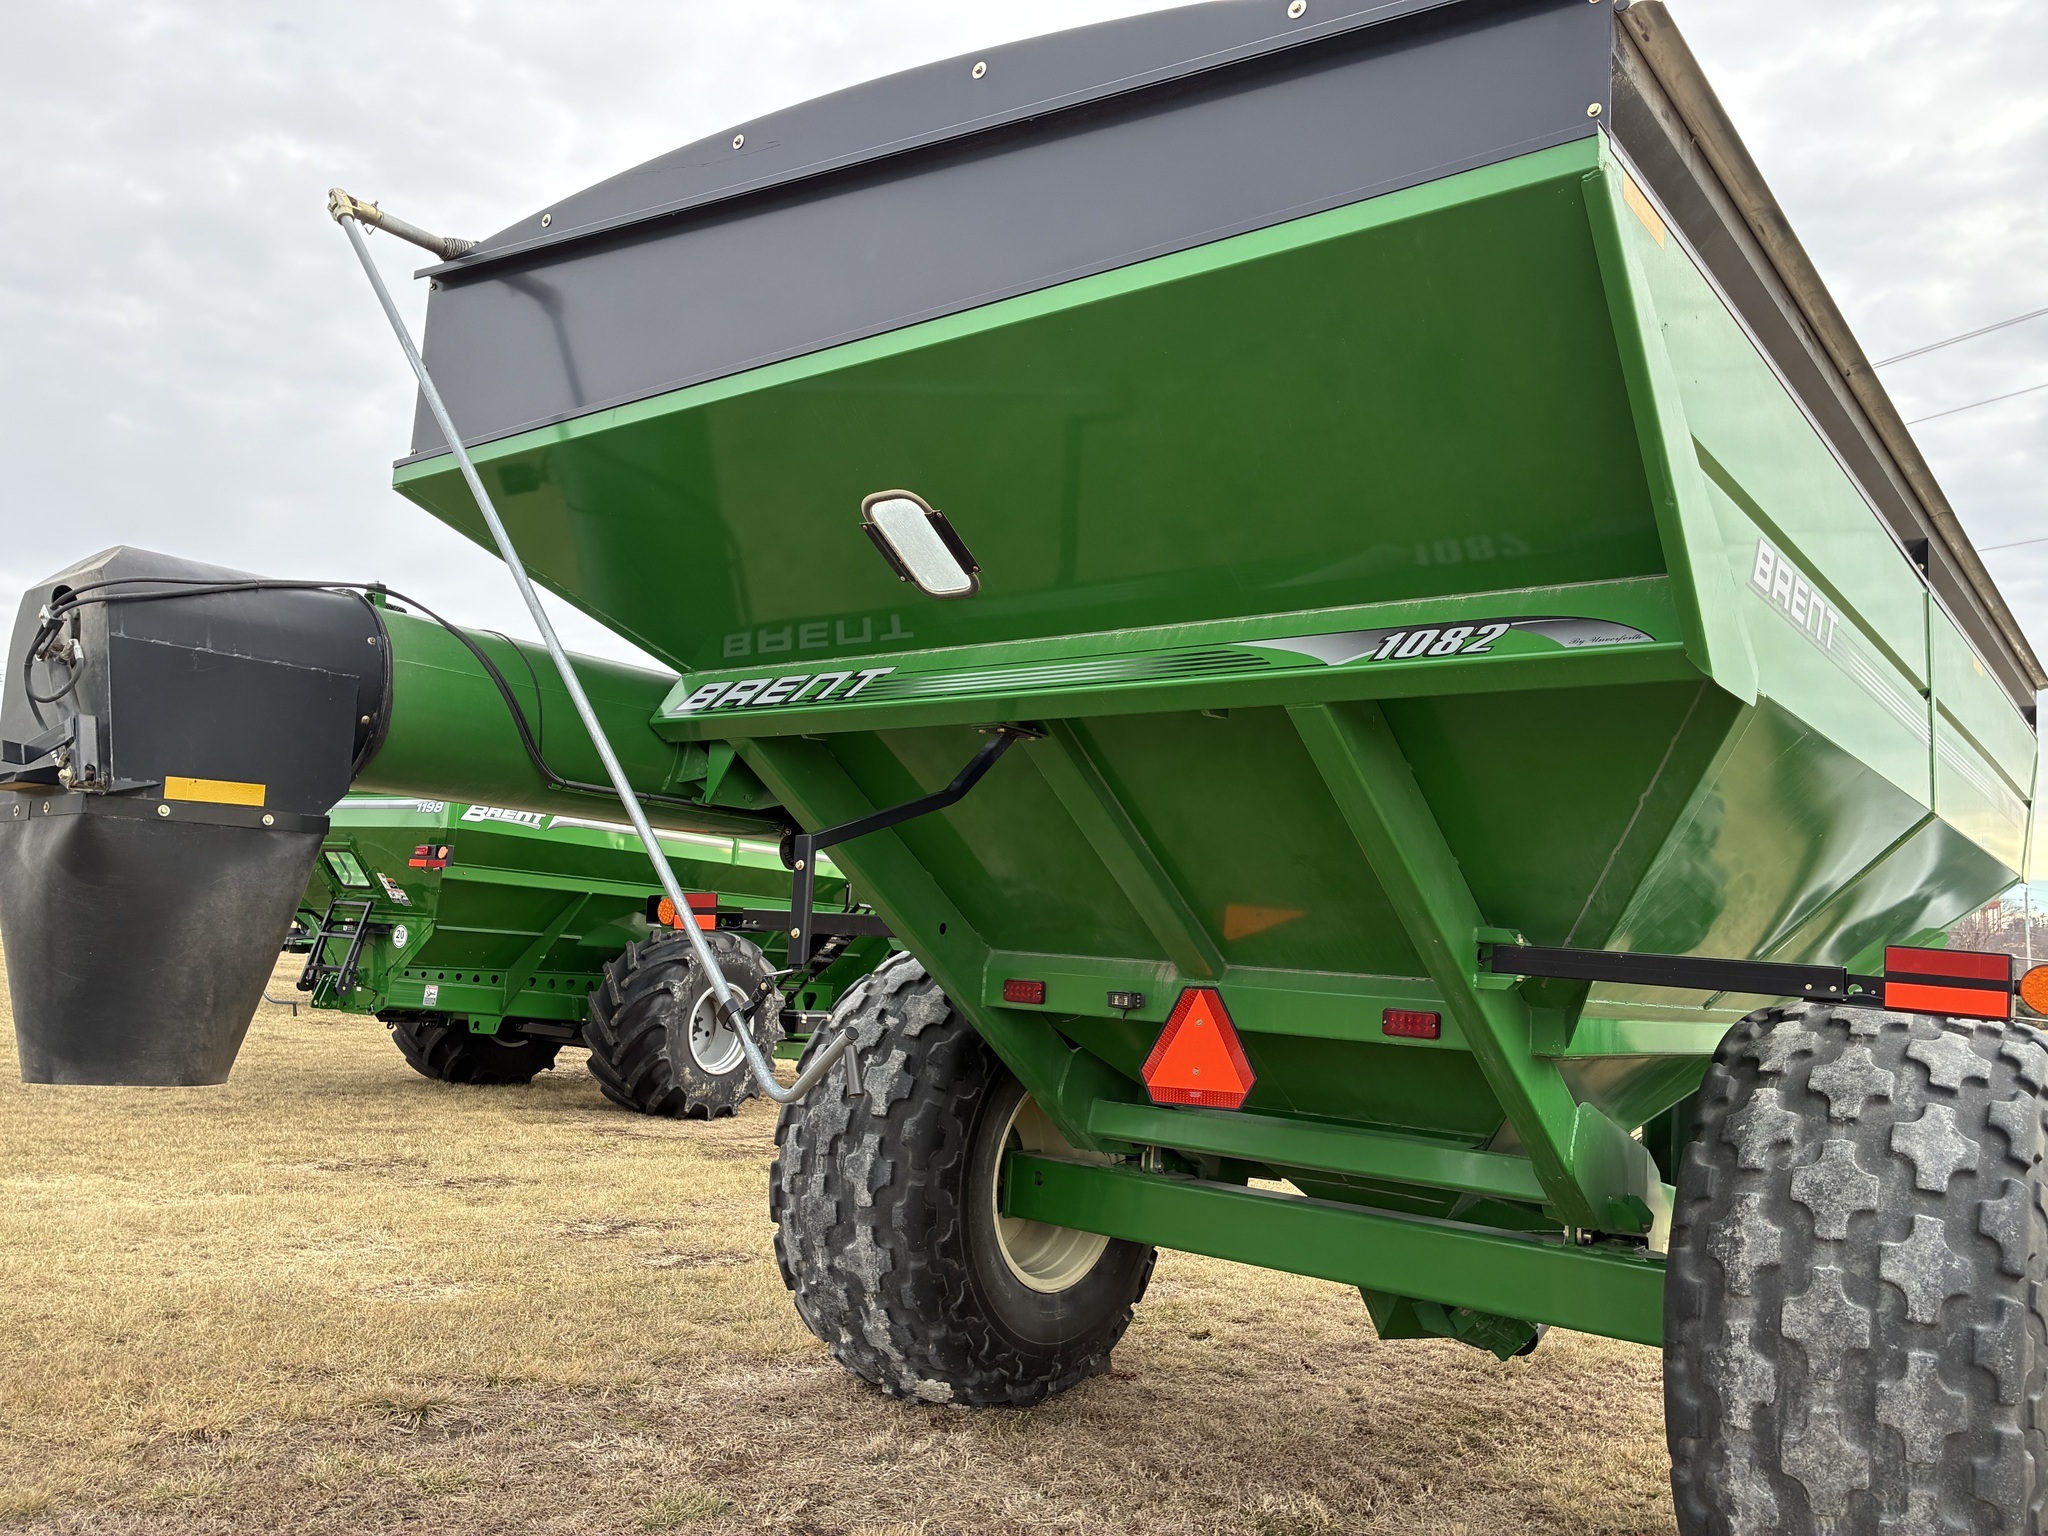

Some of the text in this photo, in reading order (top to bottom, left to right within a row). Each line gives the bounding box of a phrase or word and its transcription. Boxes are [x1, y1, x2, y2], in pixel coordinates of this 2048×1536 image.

[1751, 538, 1840, 650] BRENT
[1368, 623, 1511, 662] 1082
[1568, 637, 1585, 646] By
[676, 666, 899, 711] BRENT
[416, 801, 445, 813] 1198
[460, 804, 546, 827] BRENT
[395, 929, 405, 940] 20
